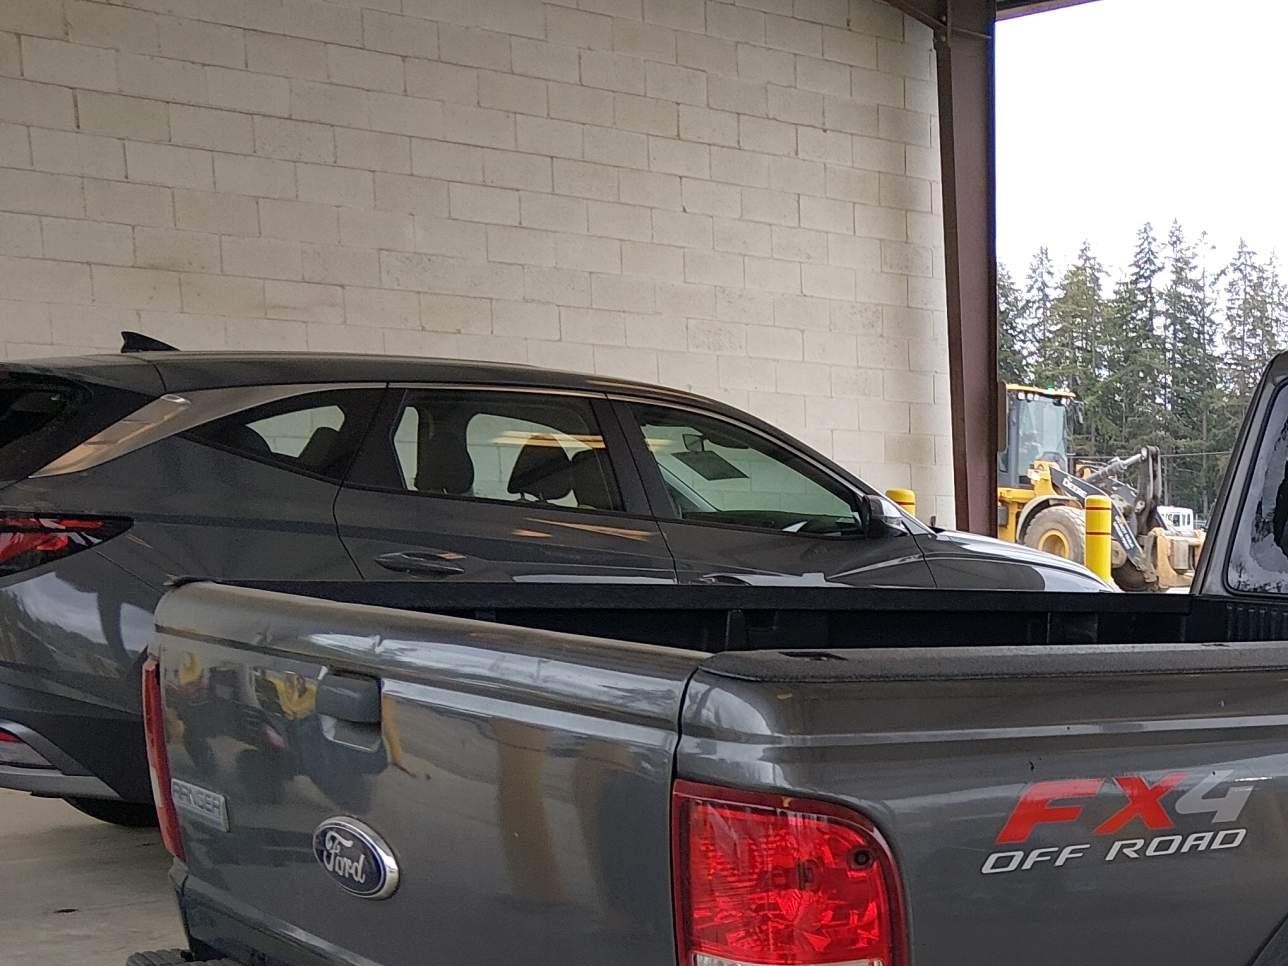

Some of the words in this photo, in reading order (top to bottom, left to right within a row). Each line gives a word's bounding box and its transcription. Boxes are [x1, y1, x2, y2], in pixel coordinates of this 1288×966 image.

[996, 768, 1254, 845] FX4
[323, 830, 366, 884] Ford
[980, 843, 1092, 875] OFF
[1104, 828, 1248, 861] ROAD
